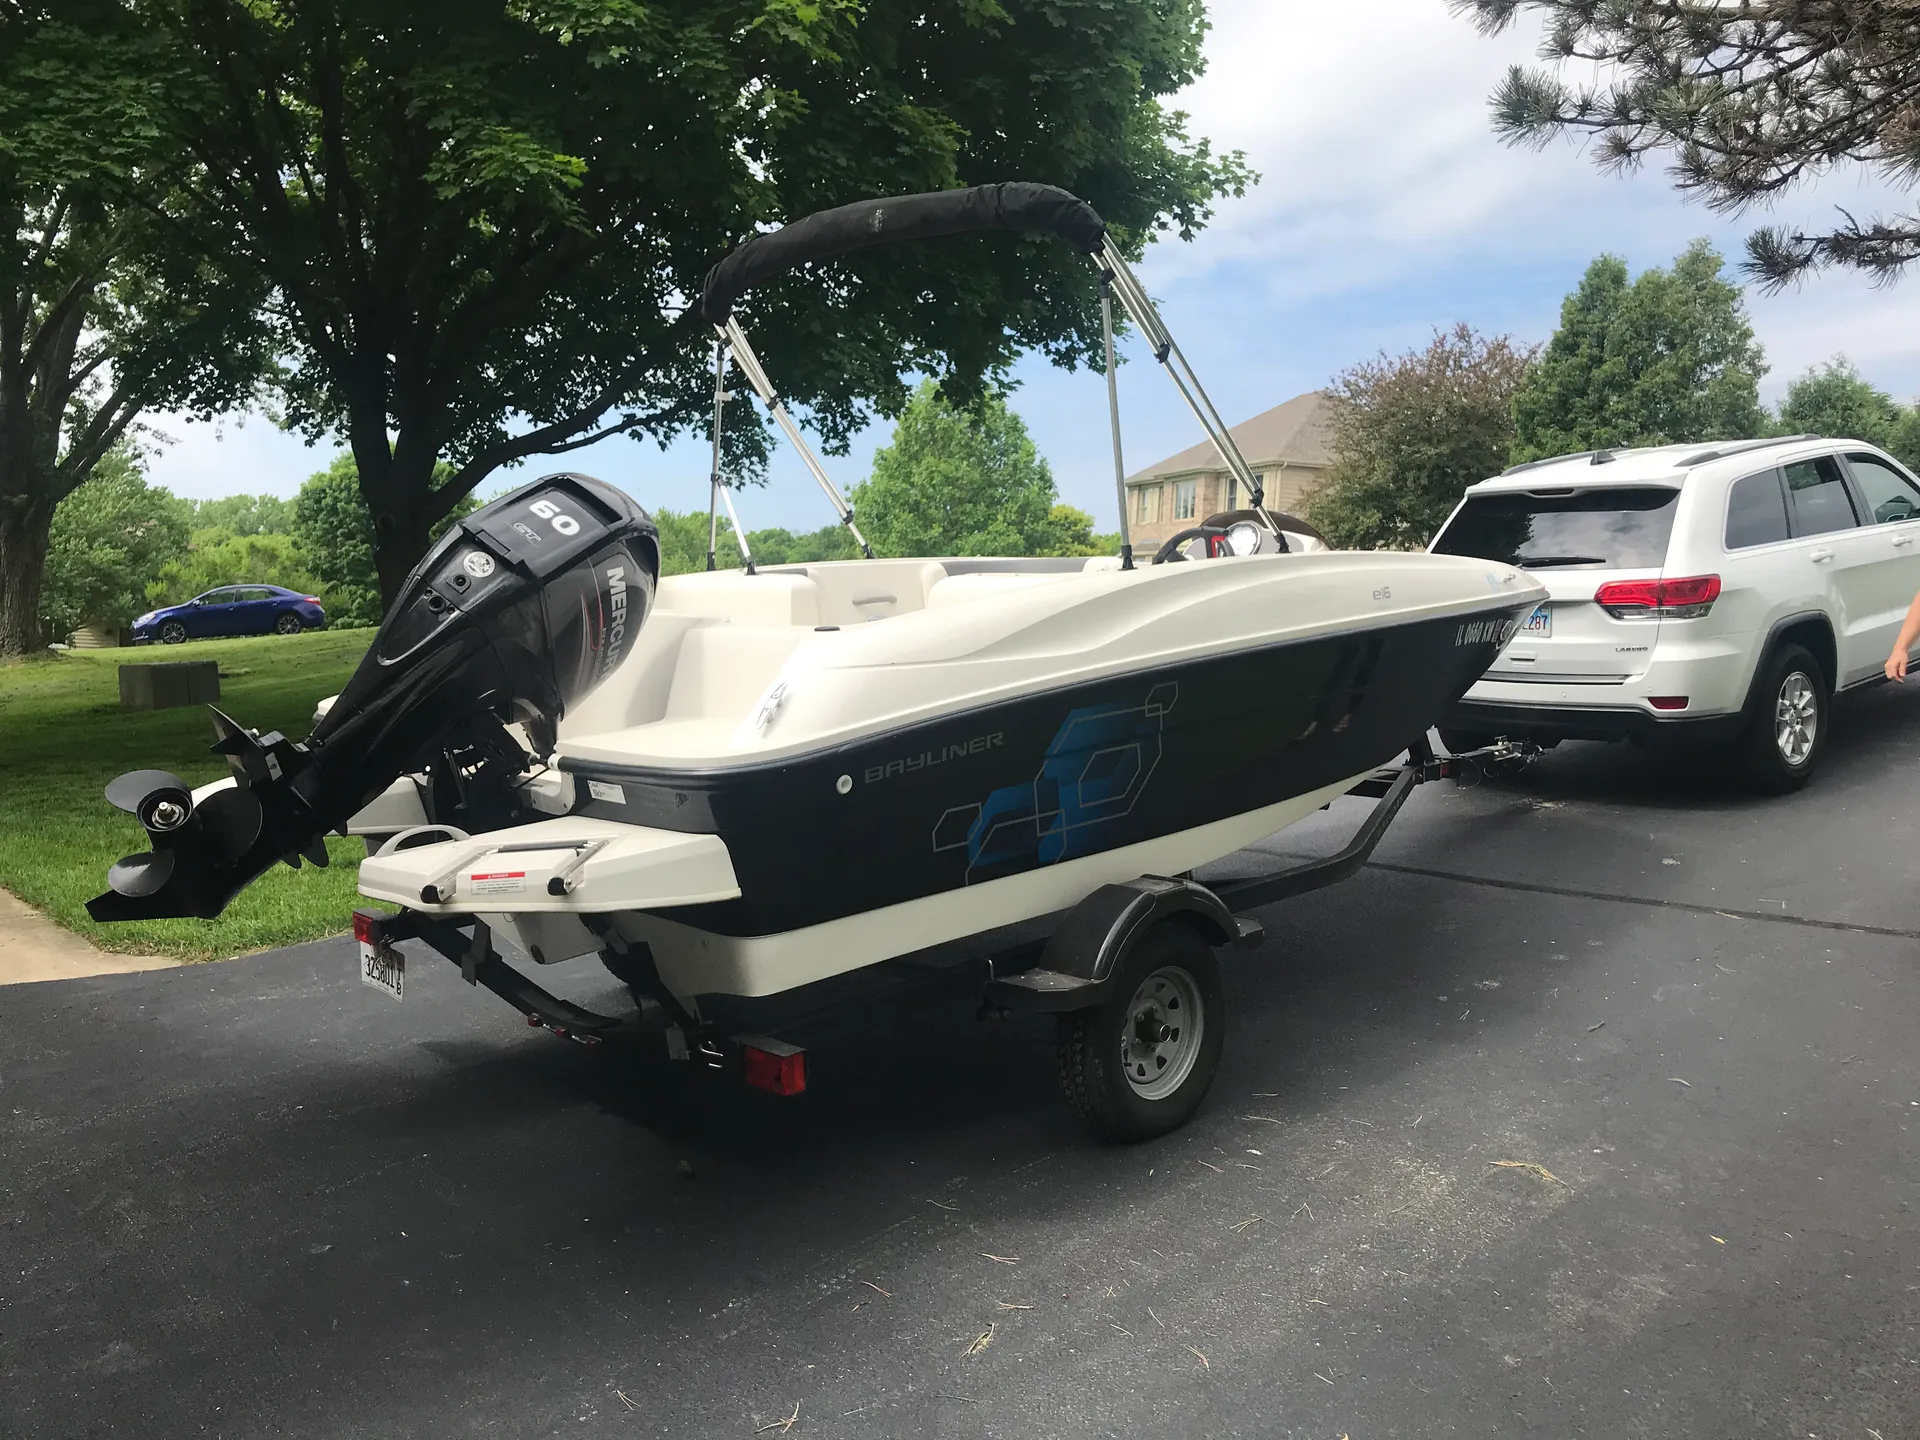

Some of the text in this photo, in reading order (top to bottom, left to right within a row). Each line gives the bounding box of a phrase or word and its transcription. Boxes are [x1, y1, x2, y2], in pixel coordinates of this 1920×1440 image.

[529, 500, 580, 536] 60
[603, 566, 627, 672] MERCUR
[864, 732, 1004, 784] BAYLINER
